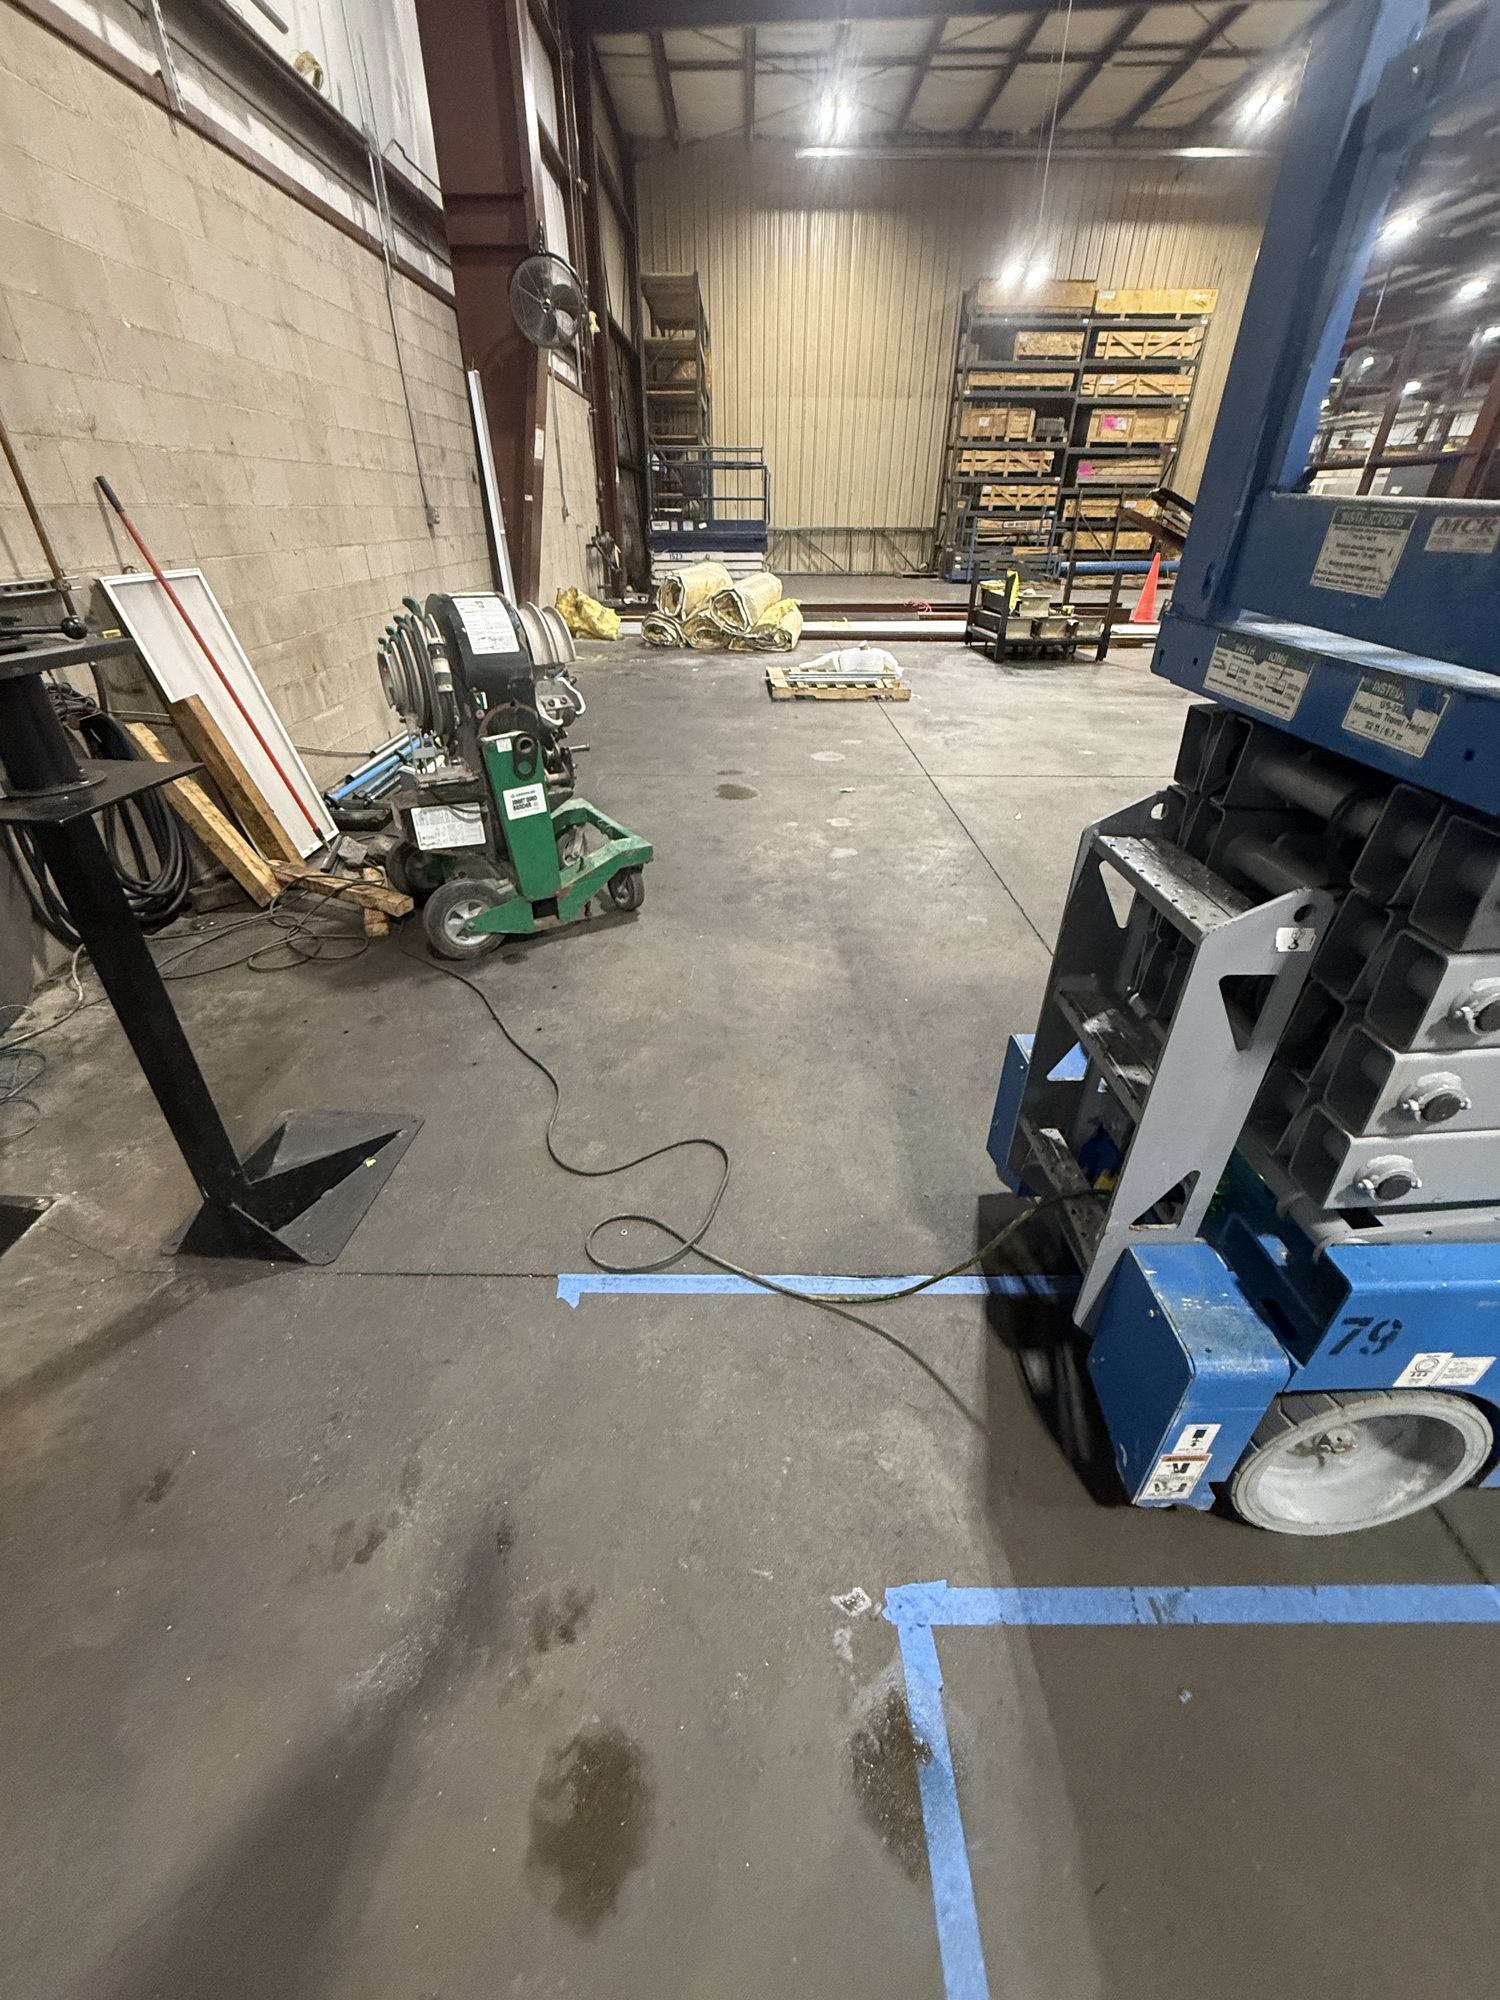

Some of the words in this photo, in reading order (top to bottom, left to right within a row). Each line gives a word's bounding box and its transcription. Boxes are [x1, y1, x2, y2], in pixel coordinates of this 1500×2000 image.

[1341, 511, 1404, 527] INSTRUCTIONS
[1353, 702, 1383, 720] Maximum
[1384, 712, 1406, 728] Travel
[1405, 721, 1431, 736] Height
[1328, 1317, 1403, 1356] 79
